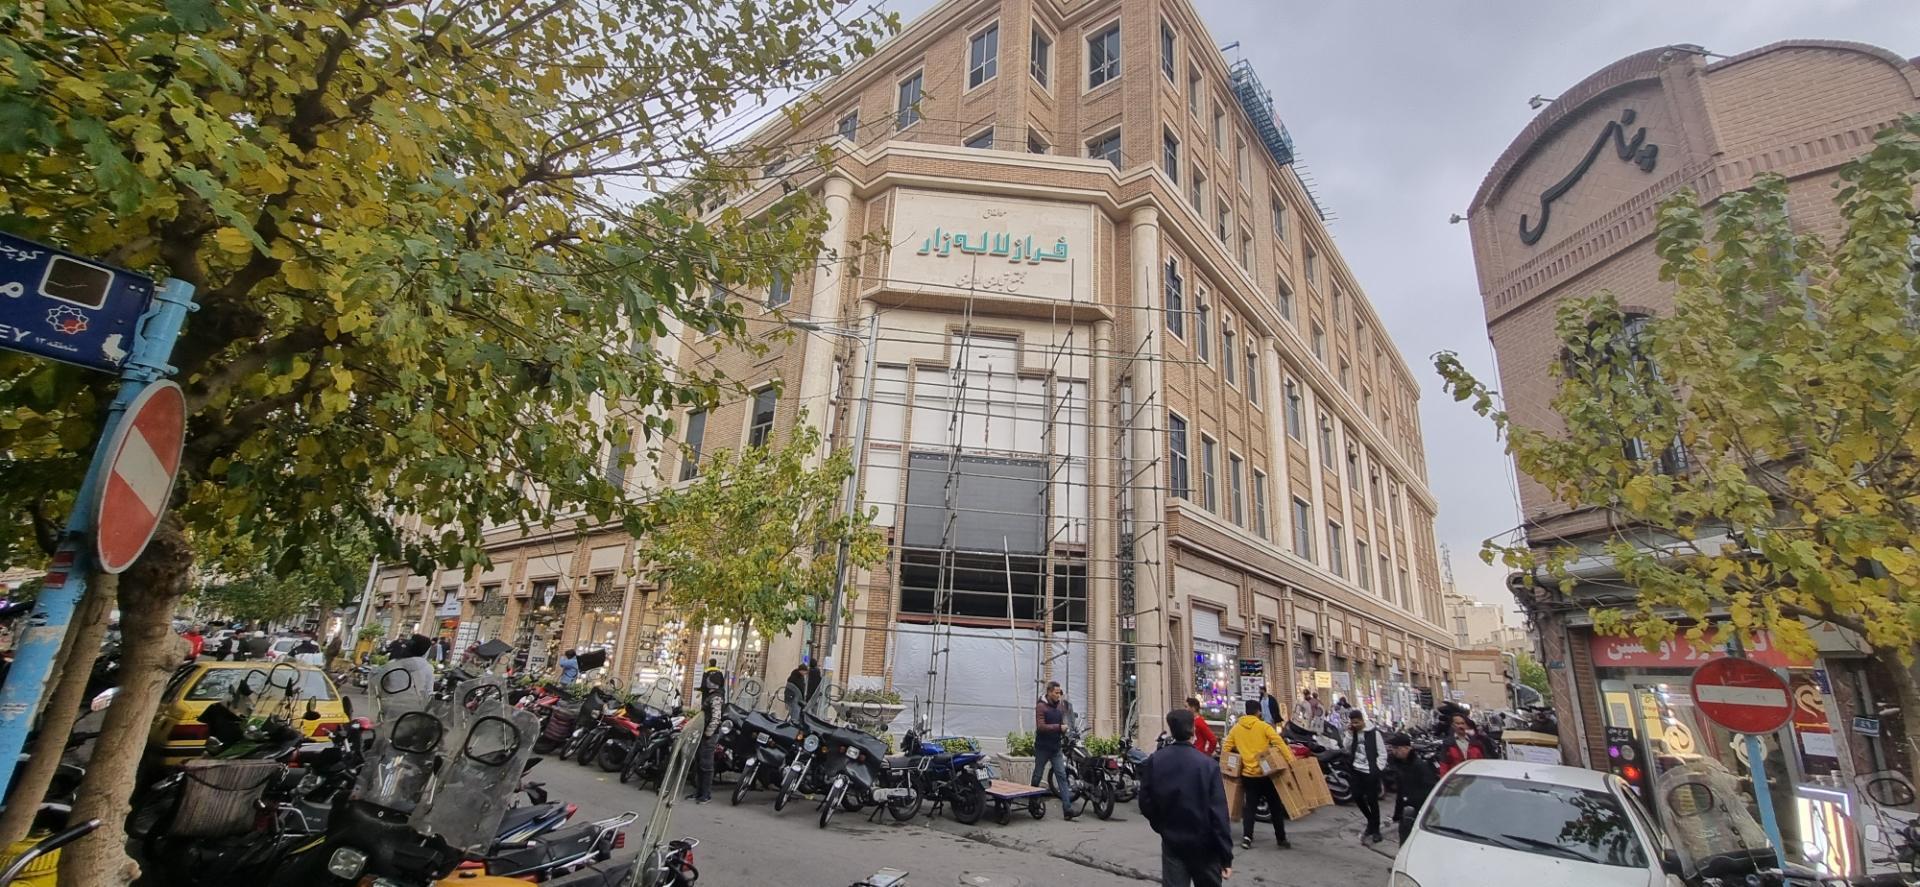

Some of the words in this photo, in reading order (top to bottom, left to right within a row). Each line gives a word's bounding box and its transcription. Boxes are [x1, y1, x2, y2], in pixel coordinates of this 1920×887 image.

[0, 245, 45, 261] کوچ
[1009, 235, 1068, 265] فراز
[0, 323, 32, 342] EY
